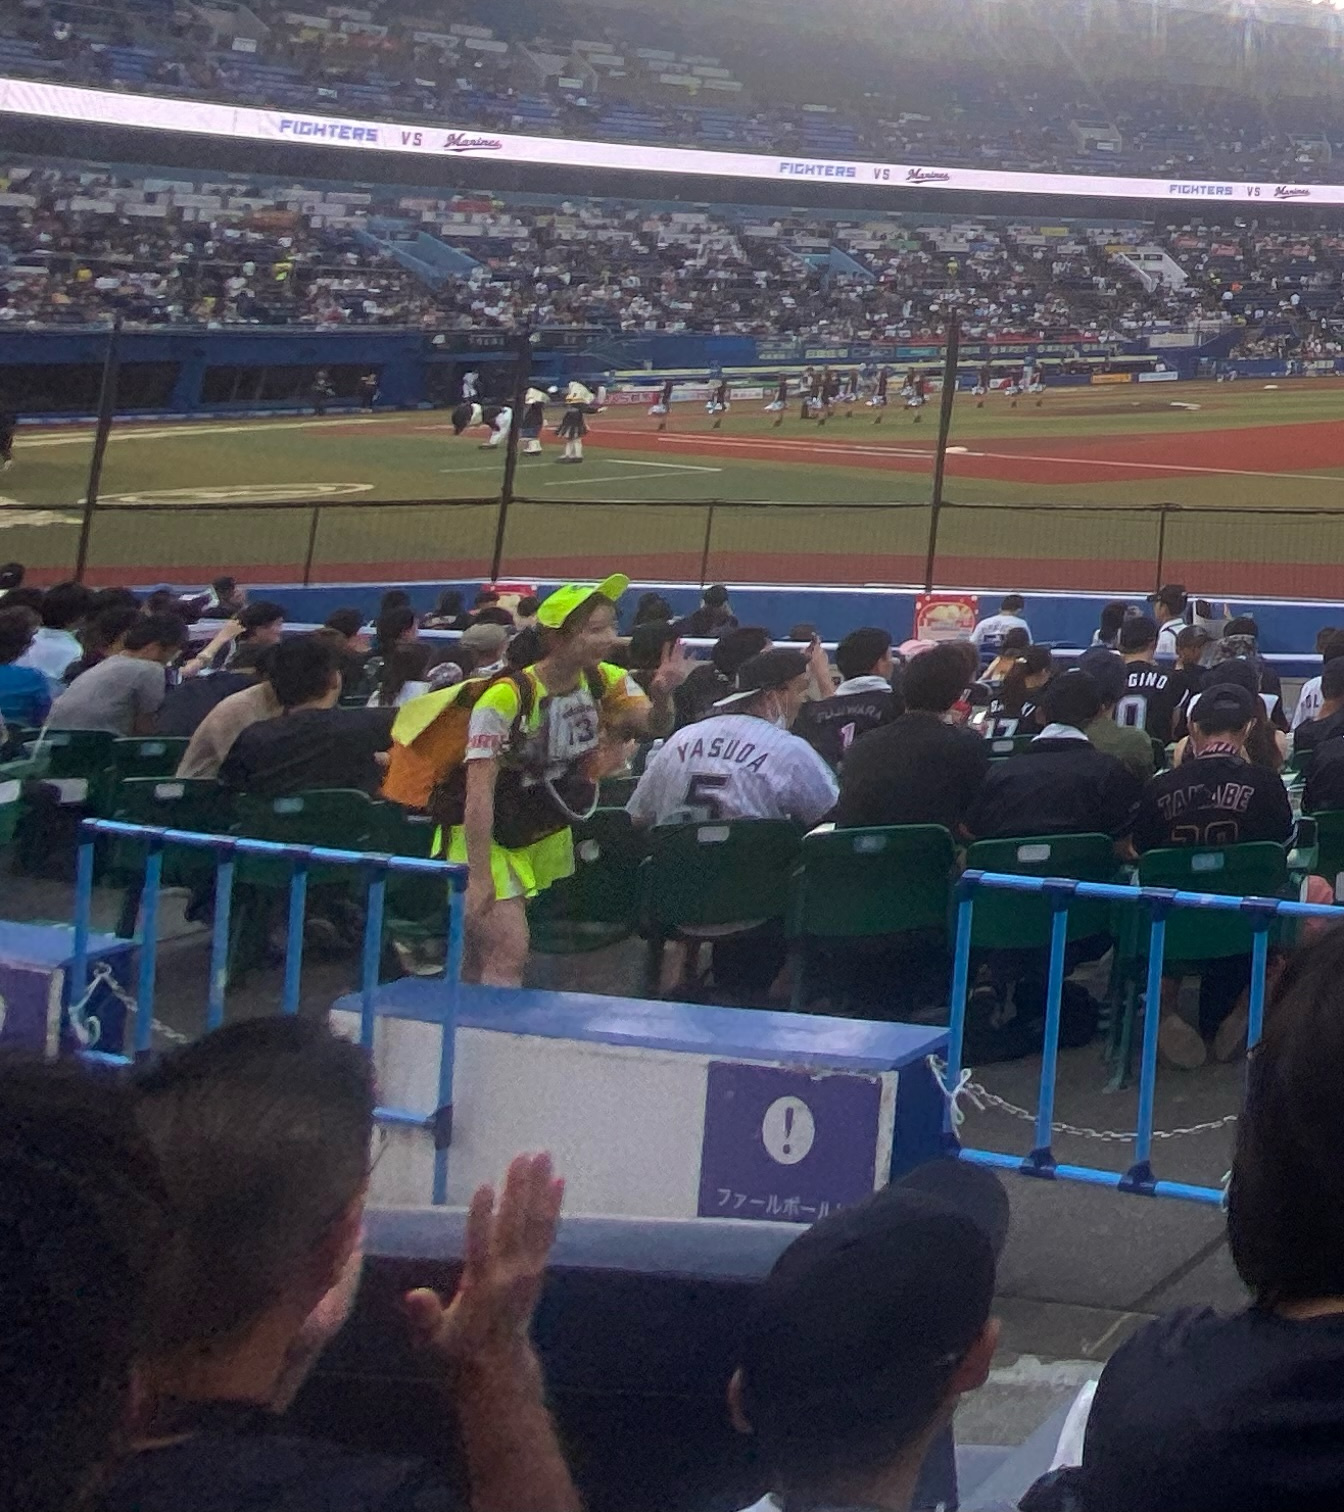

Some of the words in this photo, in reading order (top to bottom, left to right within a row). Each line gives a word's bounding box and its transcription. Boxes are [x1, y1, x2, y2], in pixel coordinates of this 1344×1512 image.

[279, 119, 379, 142] FIGHTERS
[401, 131, 422, 146] VS
[443, 133, 502, 152] Marines
[779, 162, 856, 178] FIGHTERS
[873, 168, 890, 180] VS
[906, 168, 950, 184] Marines
[1169, 184, 1233, 196] FIGHTERS
[1247, 186, 1260, 197] VS
[1128, 672, 1168, 689] GINO
[678, 738, 769, 773] YASUDA
[717, 1188, 842, 1219] ファールボール
